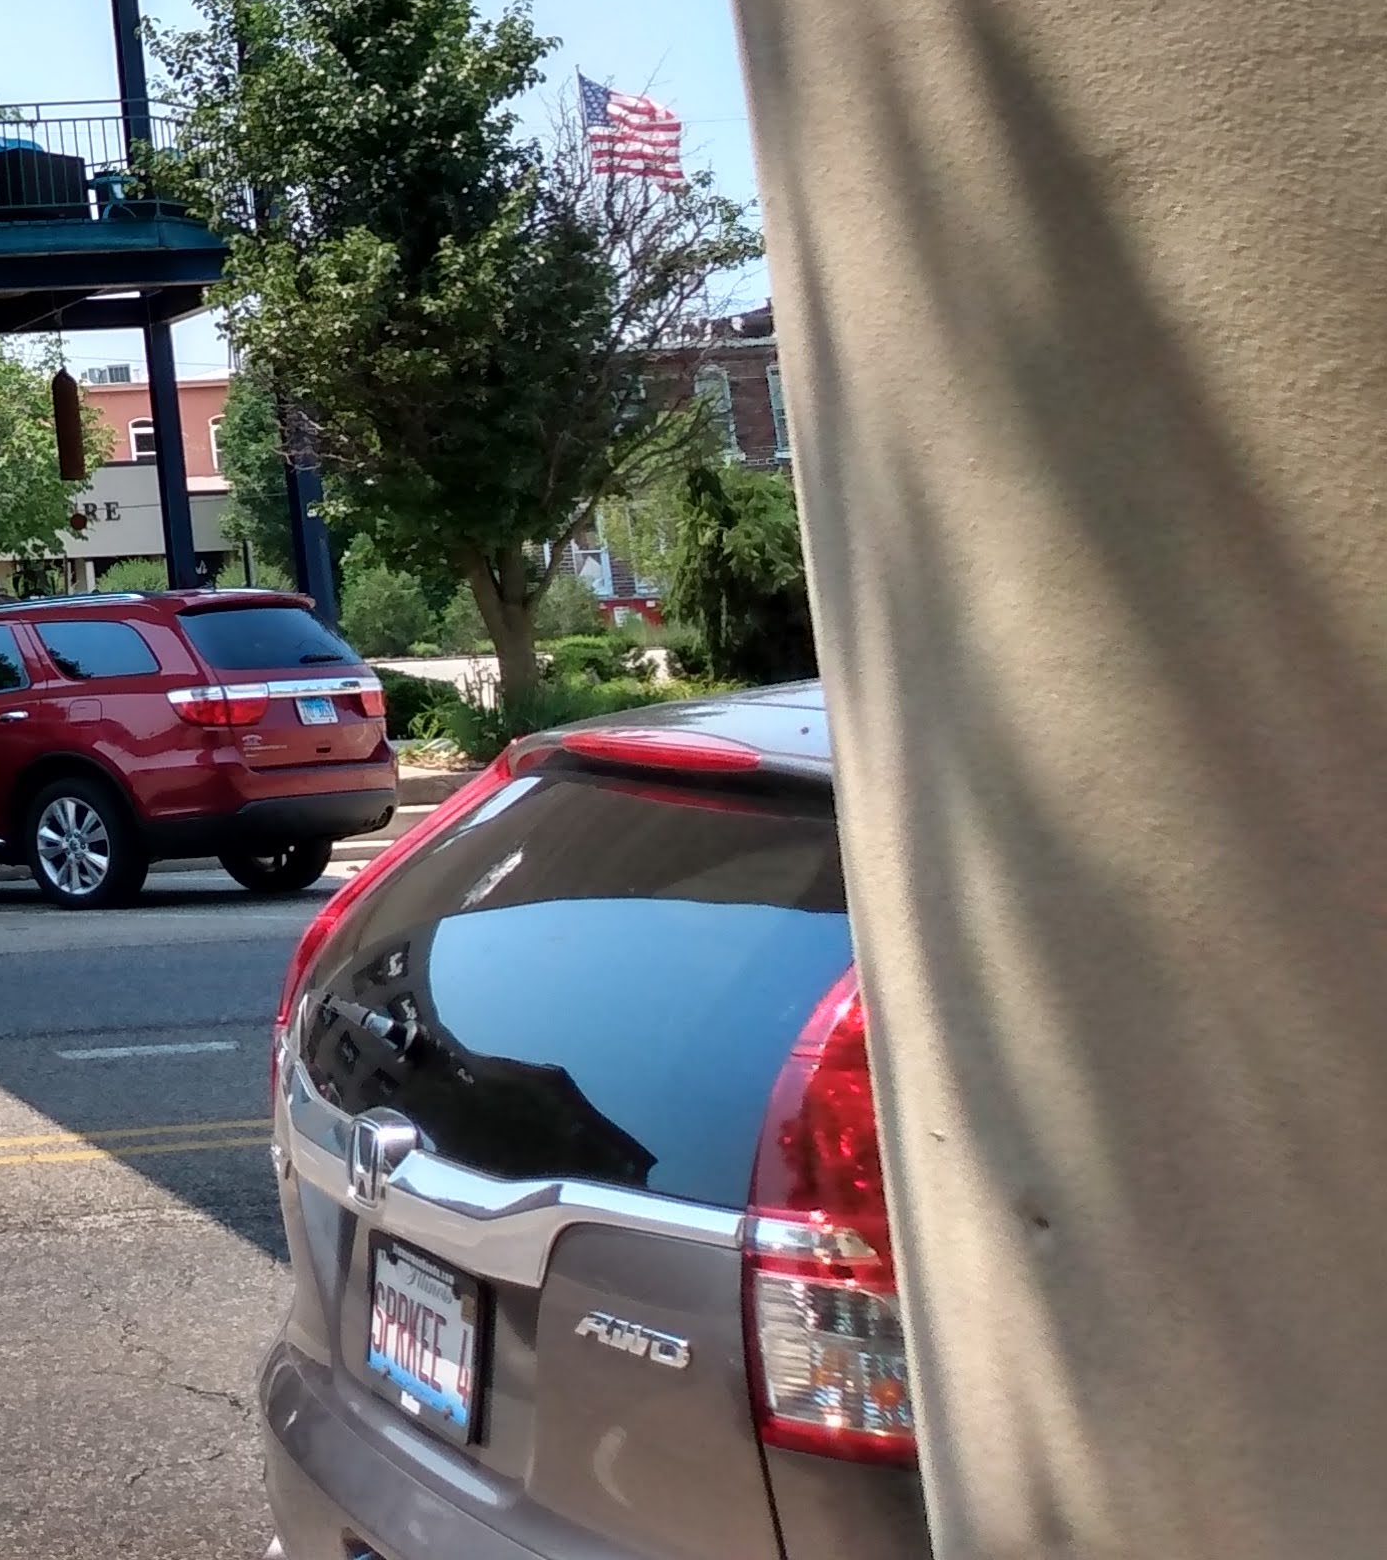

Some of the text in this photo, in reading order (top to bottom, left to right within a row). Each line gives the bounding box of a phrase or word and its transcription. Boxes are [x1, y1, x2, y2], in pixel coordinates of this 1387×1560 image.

[372, 1280, 471, 1409] SPRKEE 4
[574, 1309, 692, 1370] AWD
